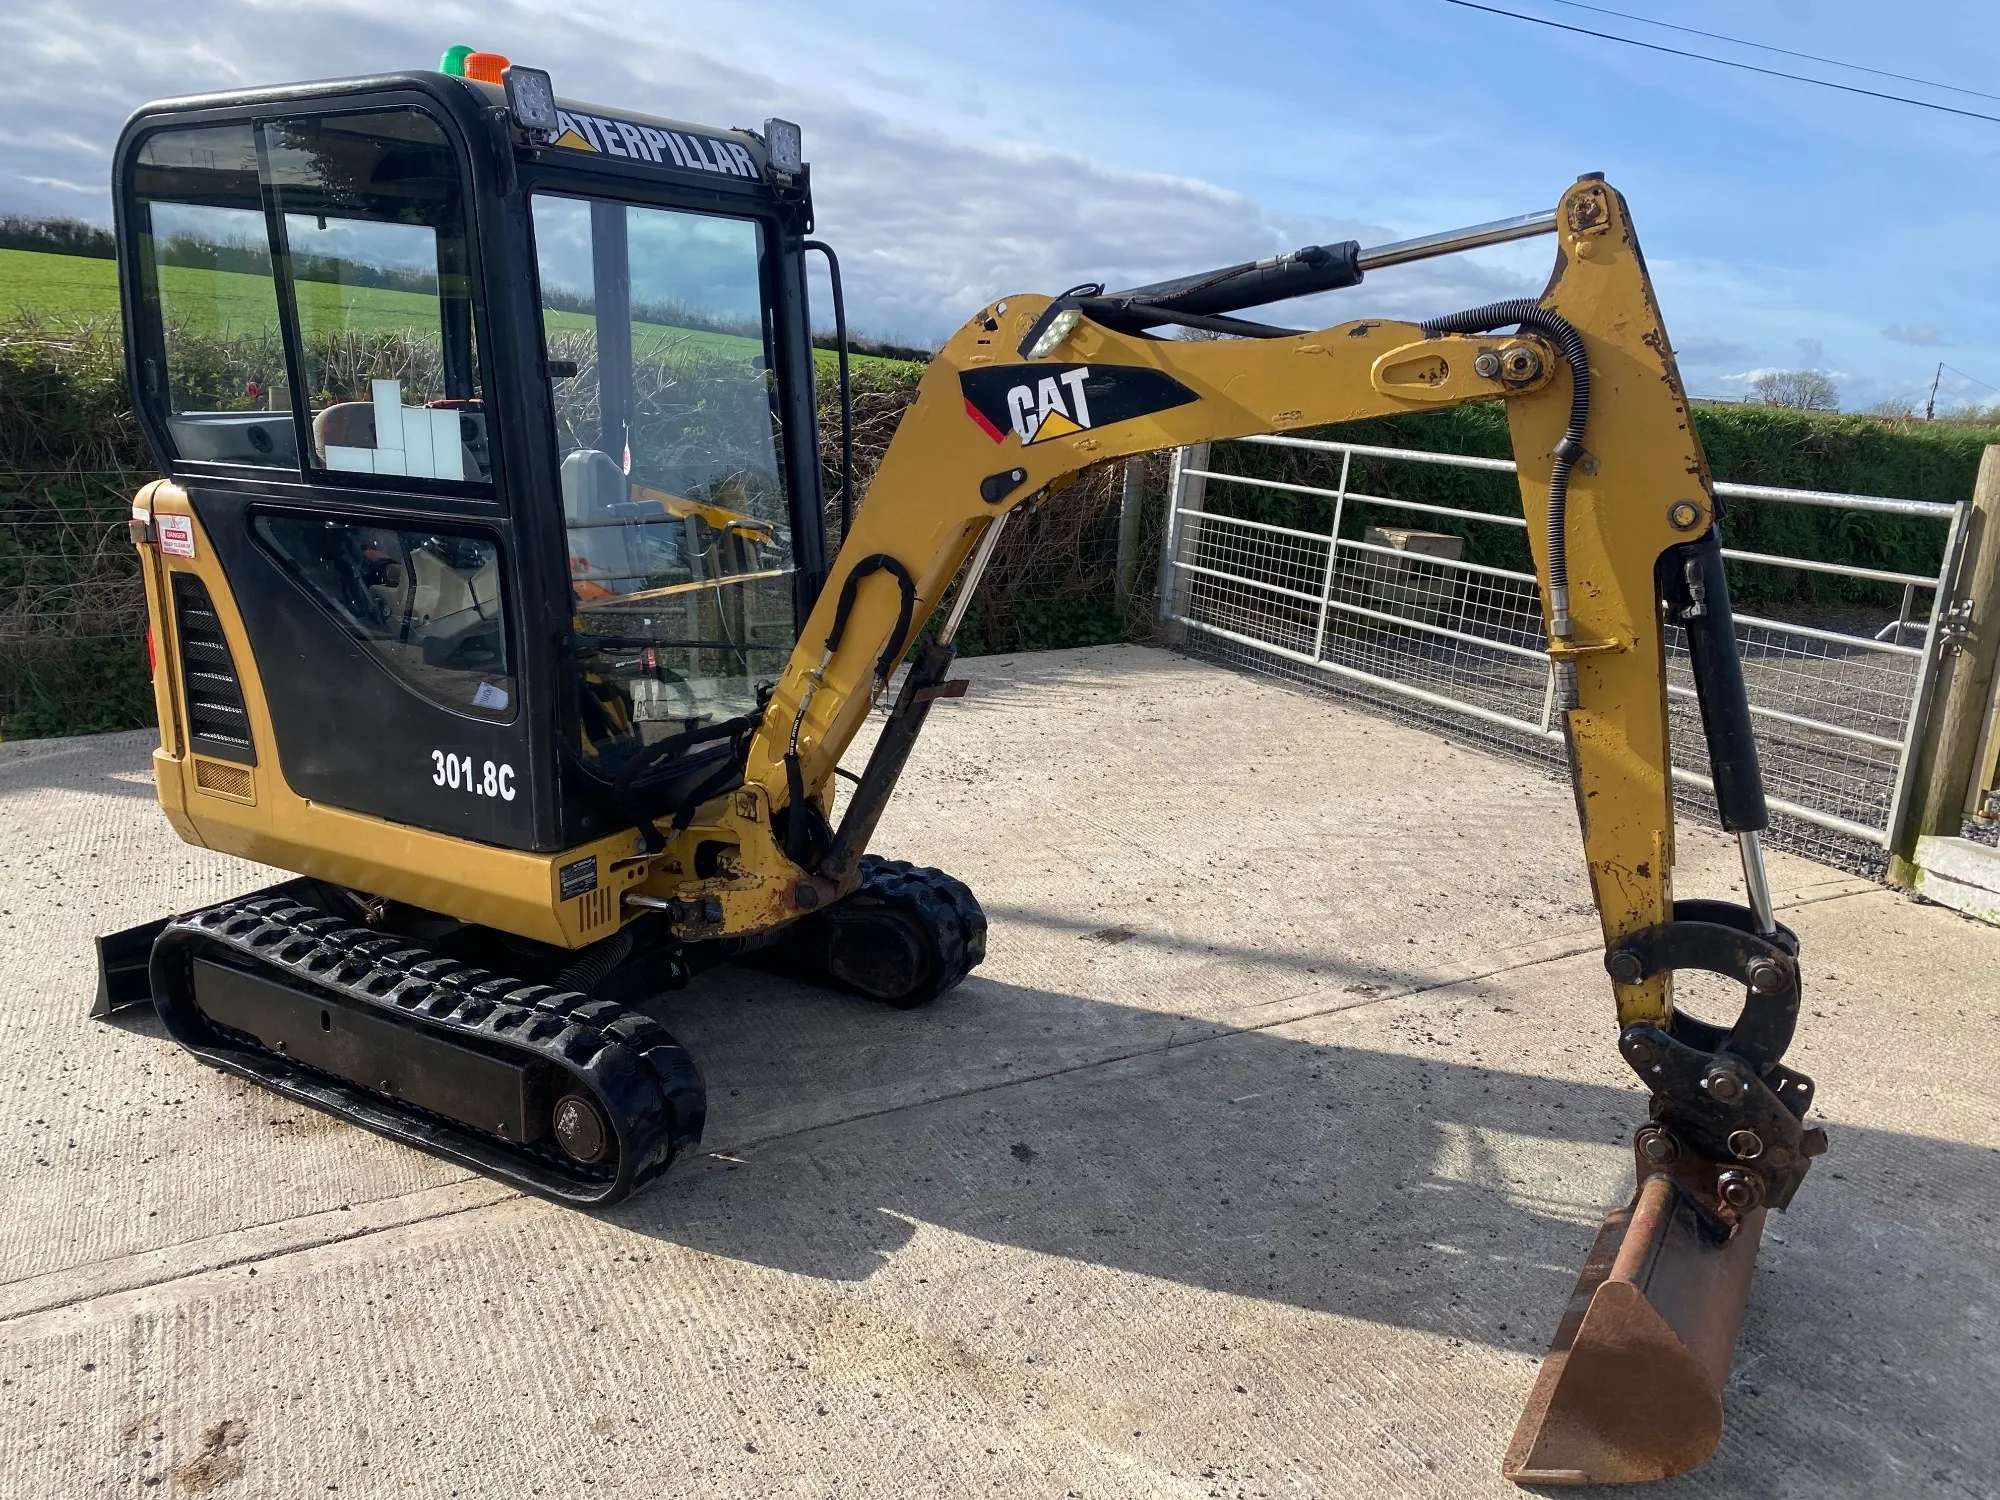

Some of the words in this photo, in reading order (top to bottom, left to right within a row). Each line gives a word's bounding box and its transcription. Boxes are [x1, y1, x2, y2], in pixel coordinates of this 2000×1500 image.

[549, 110, 760, 179] ATERPILLAR
[1007, 366, 1091, 446] CAT
[431, 749, 516, 801] 301.8C
